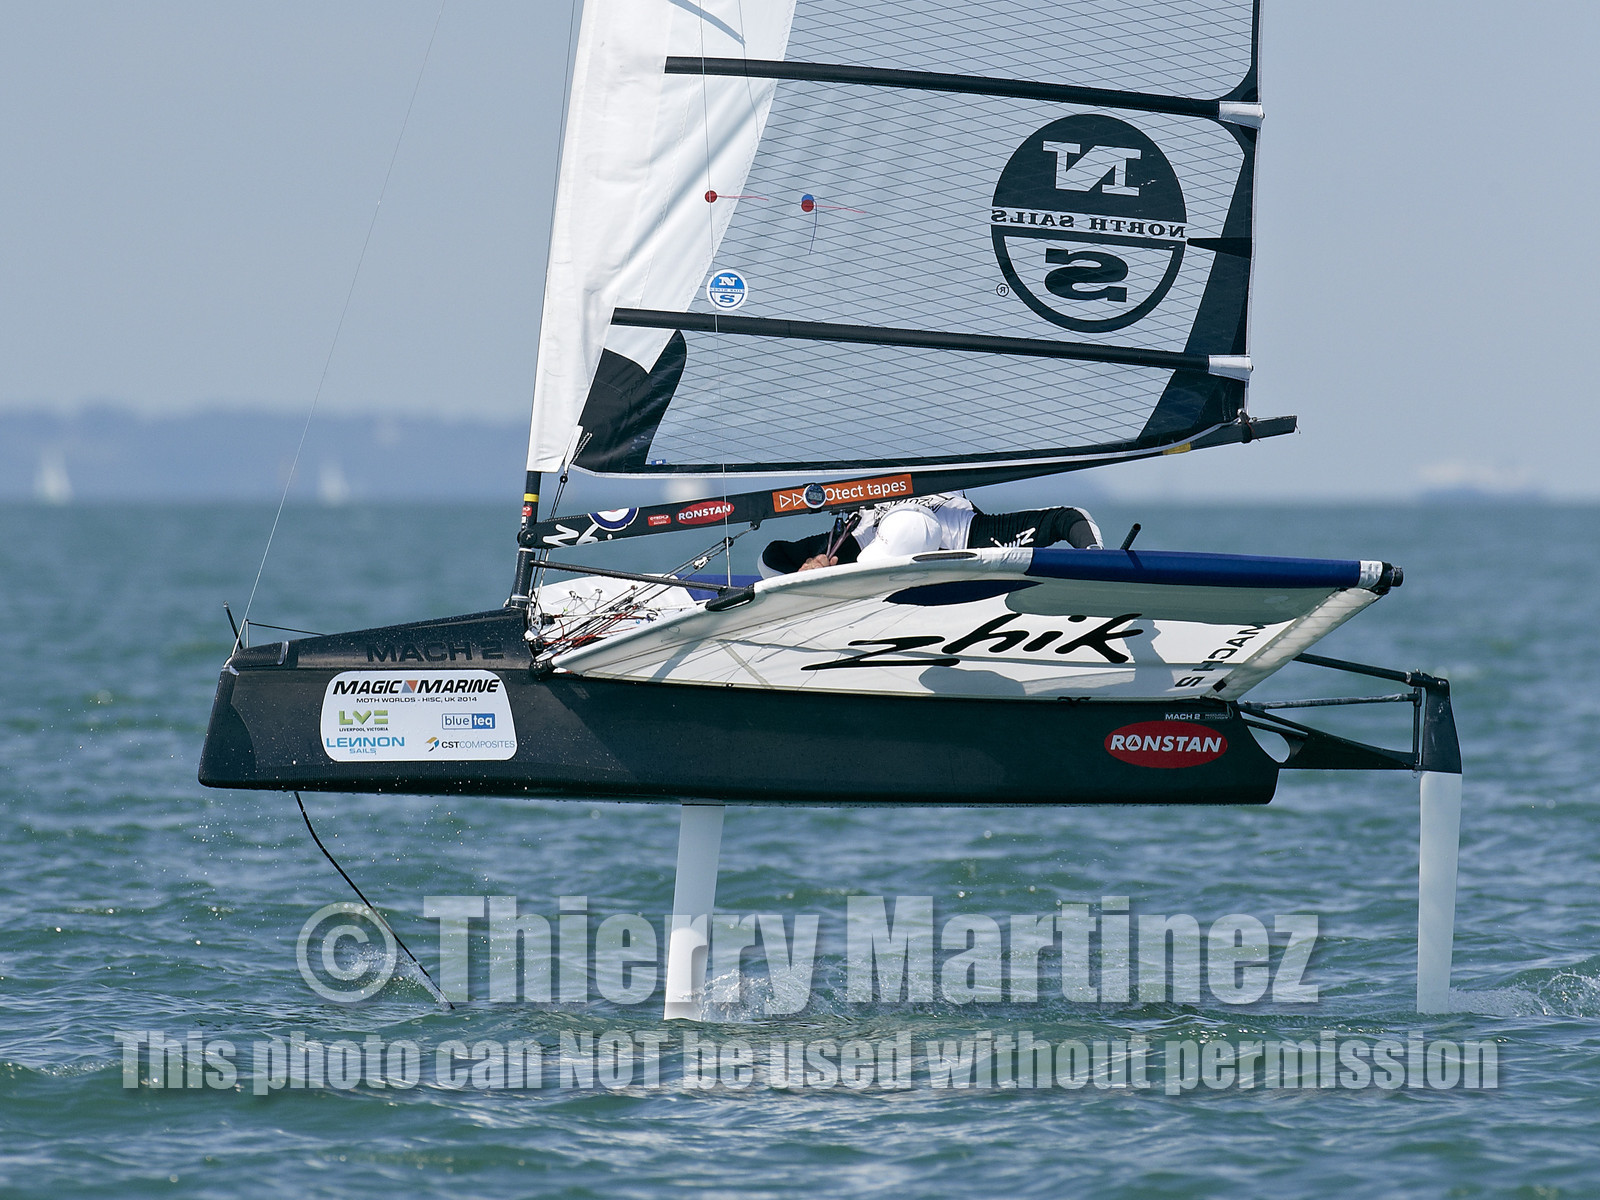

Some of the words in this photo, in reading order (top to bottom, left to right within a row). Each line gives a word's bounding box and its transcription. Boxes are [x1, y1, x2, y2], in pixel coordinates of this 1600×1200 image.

[719, 276, 737, 286] N
[720, 294, 735, 303] S
[868, 480, 907, 497] tapes
[678, 504, 731, 521] RONSTAN
[366, 641, 473, 662] MACH
[481, 640, 505, 660] 2
[333, 680, 402, 695] MAGIC
[417, 679, 500, 694] MARINE
[326, 736, 405, 747] LENNON
[1110, 734, 1222, 753] RONSTAN
